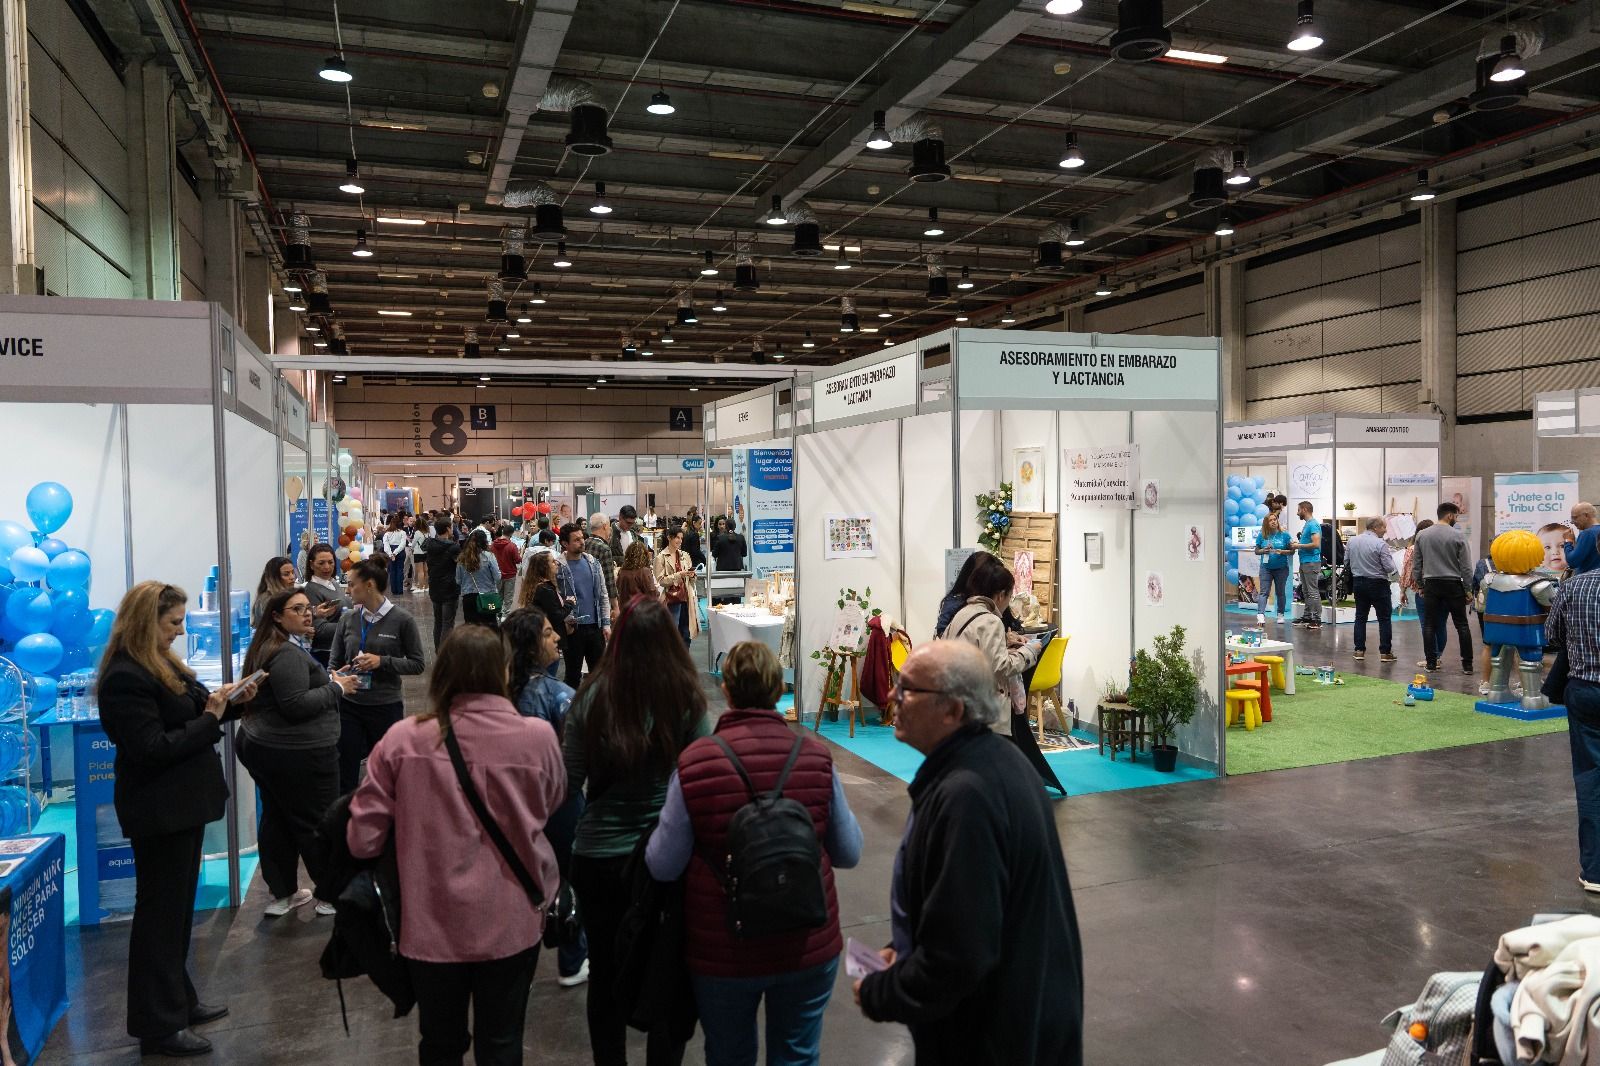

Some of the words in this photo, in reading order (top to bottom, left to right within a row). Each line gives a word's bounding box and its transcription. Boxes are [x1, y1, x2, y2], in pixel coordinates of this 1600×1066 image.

[999, 350, 1098, 367] ASESORAMIENTO
[1100, 353, 1115, 368] EN
[1118, 354, 1177, 369] EMBARAZO
[1052, 371, 1060, 385] Y
[1063, 371, 1125, 386] LACTANCIA
[478, 407, 488, 420] B
[676, 410, 687, 421] A
[429, 404, 468, 456] 8
[685, 460, 712, 468] SMILET
[755, 457, 773, 466] lugar
[1554, 491, 1565, 501] la
[1508, 503, 1535, 512] Tribu
[1537, 502, 1563, 512] CSC!
[88, 761, 114, 770] Pide
[35, 880, 59, 909] PARA
[10, 907, 45, 949] CRECER
[11, 934, 35, 966] SOLO
